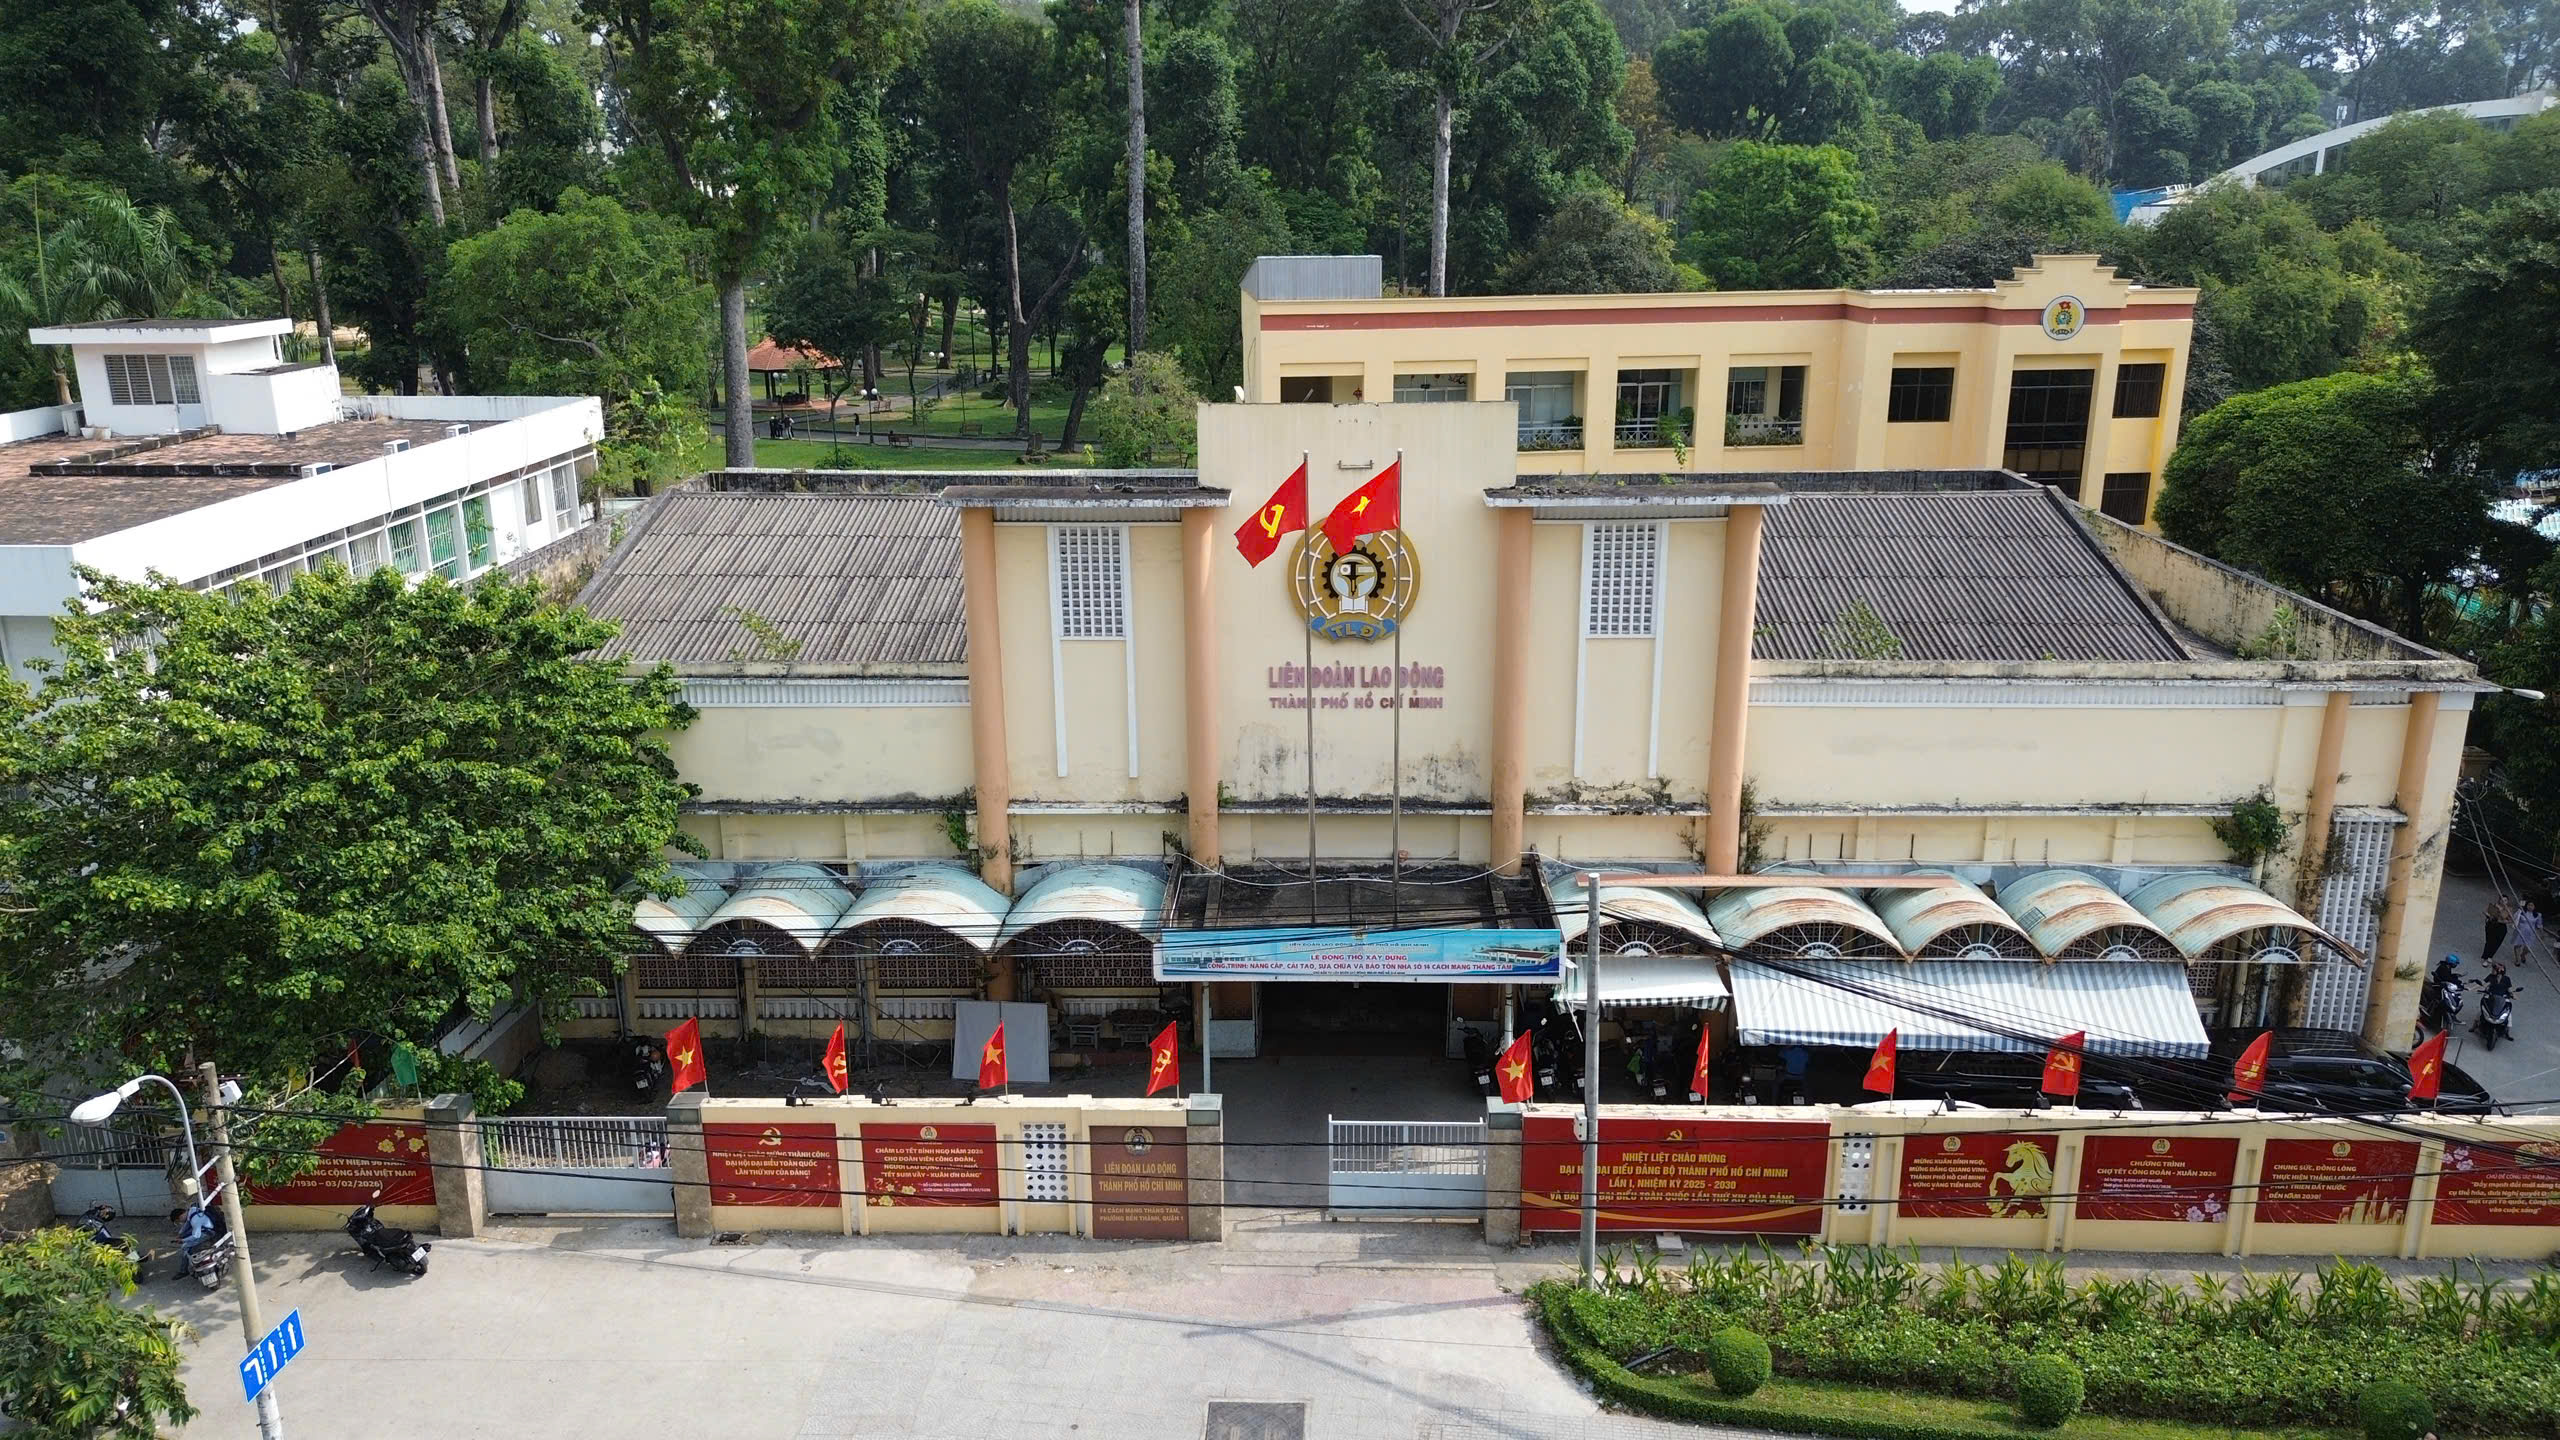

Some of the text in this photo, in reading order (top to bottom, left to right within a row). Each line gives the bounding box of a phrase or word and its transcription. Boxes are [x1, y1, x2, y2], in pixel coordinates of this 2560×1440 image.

[1269, 660, 1444, 695] LIÊN ĐOÀN LAO ĐỘNG
[1269, 691, 1443, 708] THÀNH PHỐ HỒ CHÍ MINH
[1622, 1152, 1726, 1163] NHIỆT LIỆT CHÀO MỪNG
[1104, 1161, 1176, 1176] LIÊN ĐOÀN LAO ĐỘNG
[1560, 1165, 1575, 1175] ĐẠI
[1596, 1165, 1610, 1175] ĐẠI
[1613, 1163, 1633, 1174] BIỂU
[1636, 1163, 1660, 1174] ĐẢNG
[1663, 1165, 1675, 1176] BỘ
[1678, 1165, 1707, 1175] THÀNH
[1710, 1165, 1728, 1176] PHỐ
[1731, 1165, 1744, 1176] HỒ
[1746, 1166, 1760, 1176] CHÍ
[1763, 1168, 1788, 1177] MINH
[1099, 1177, 1183, 1191] THÀNH PHỐ HỒ CHÍ MINH
[1629, 1179, 1635, 1188] I,
[1637, 1179, 1667, 1188] NHIỆM
[1683, 1180, 1705, 1188] 2025
[1714, 1181, 1736, 1189] 2030
